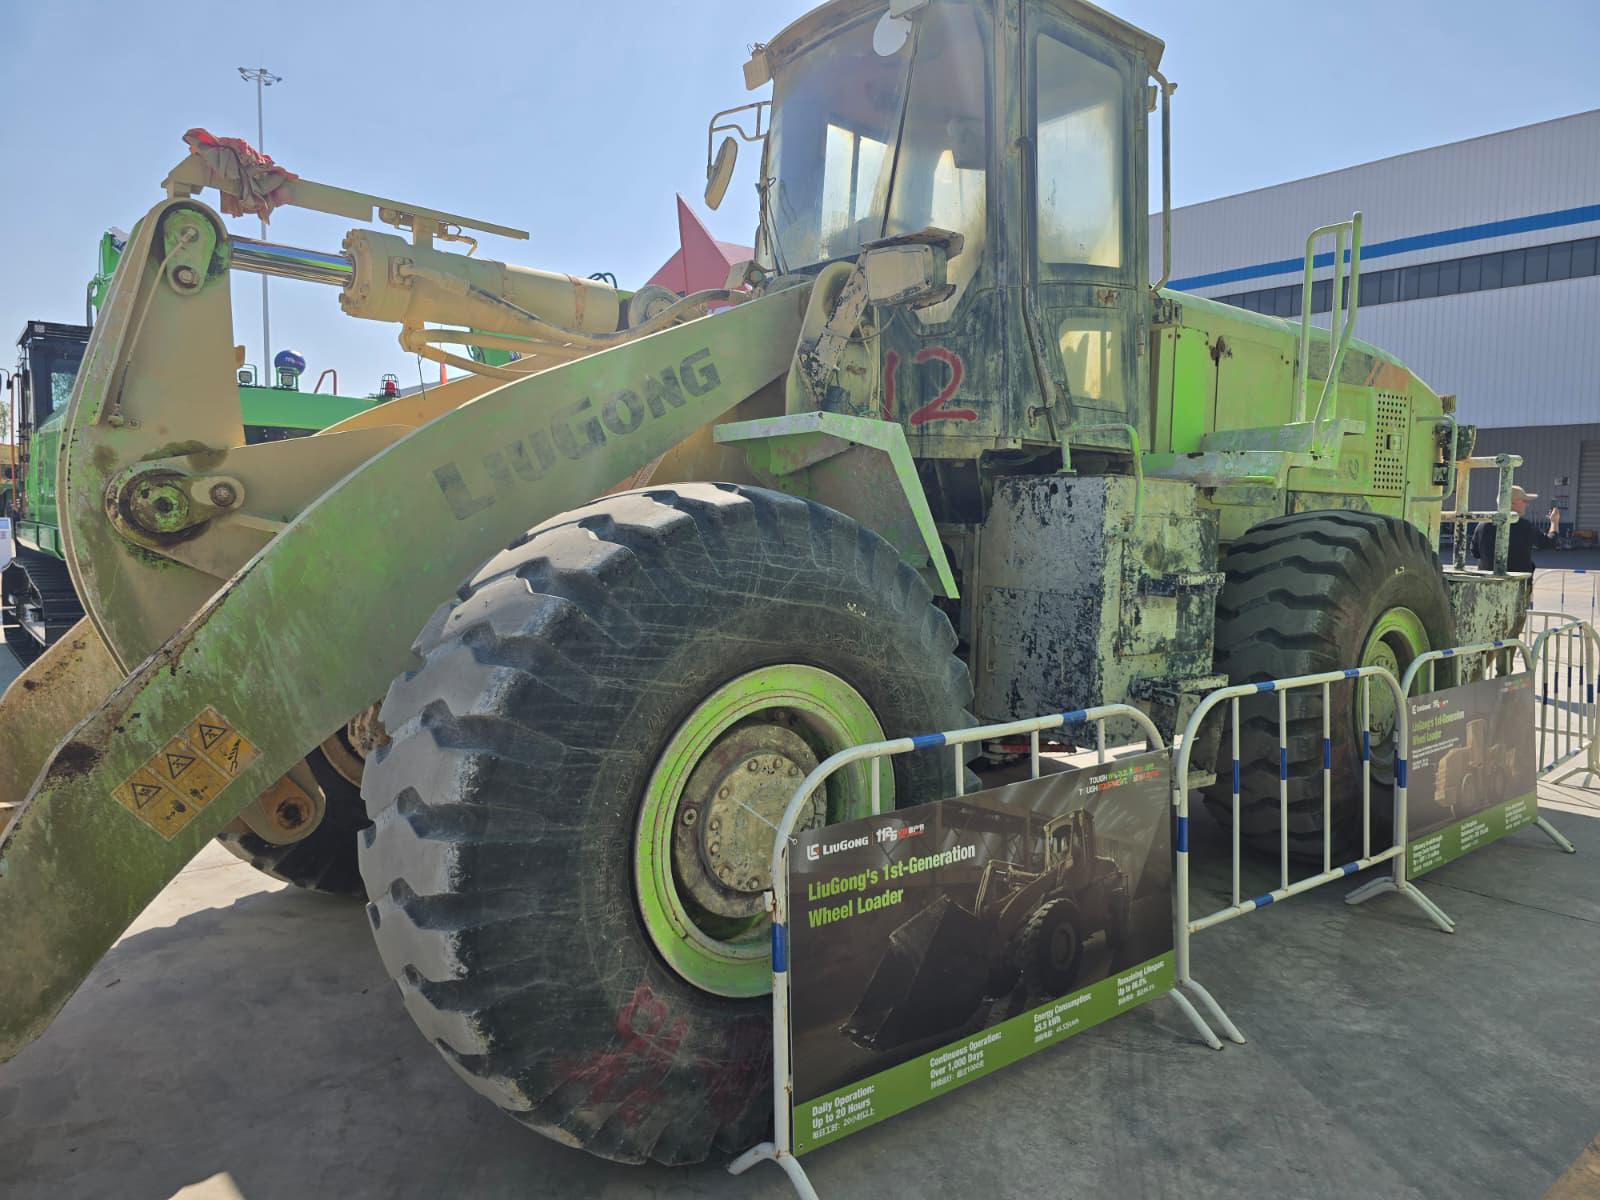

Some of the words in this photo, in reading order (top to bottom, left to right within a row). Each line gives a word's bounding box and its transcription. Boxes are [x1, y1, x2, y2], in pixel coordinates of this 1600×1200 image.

[883, 346, 978, 425] 12
[1078, 784, 1099, 796] TUGH
[1089, 773, 1108, 784] TOUGH
[808, 869, 878, 902] LiuGong's
[883, 844, 976, 881] 1st-Generation
[808, 897, 853, 928] Wheel
[857, 888, 904, 914] Loader
[930, 1046, 968, 1068] Continuous
[968, 1031, 1002, 1051] Operation:
[930, 1066, 946, 1079] Over
[967, 1049, 984, 1063] Days
[812, 1101, 833, 1117] Daily
[834, 1084, 875, 1107] Operation:
[812, 1117, 824, 1129] Up
[825, 1113, 834, 1124] to
[835, 1106, 847, 1120] 20
[847, 1098, 871, 1114] Hours
